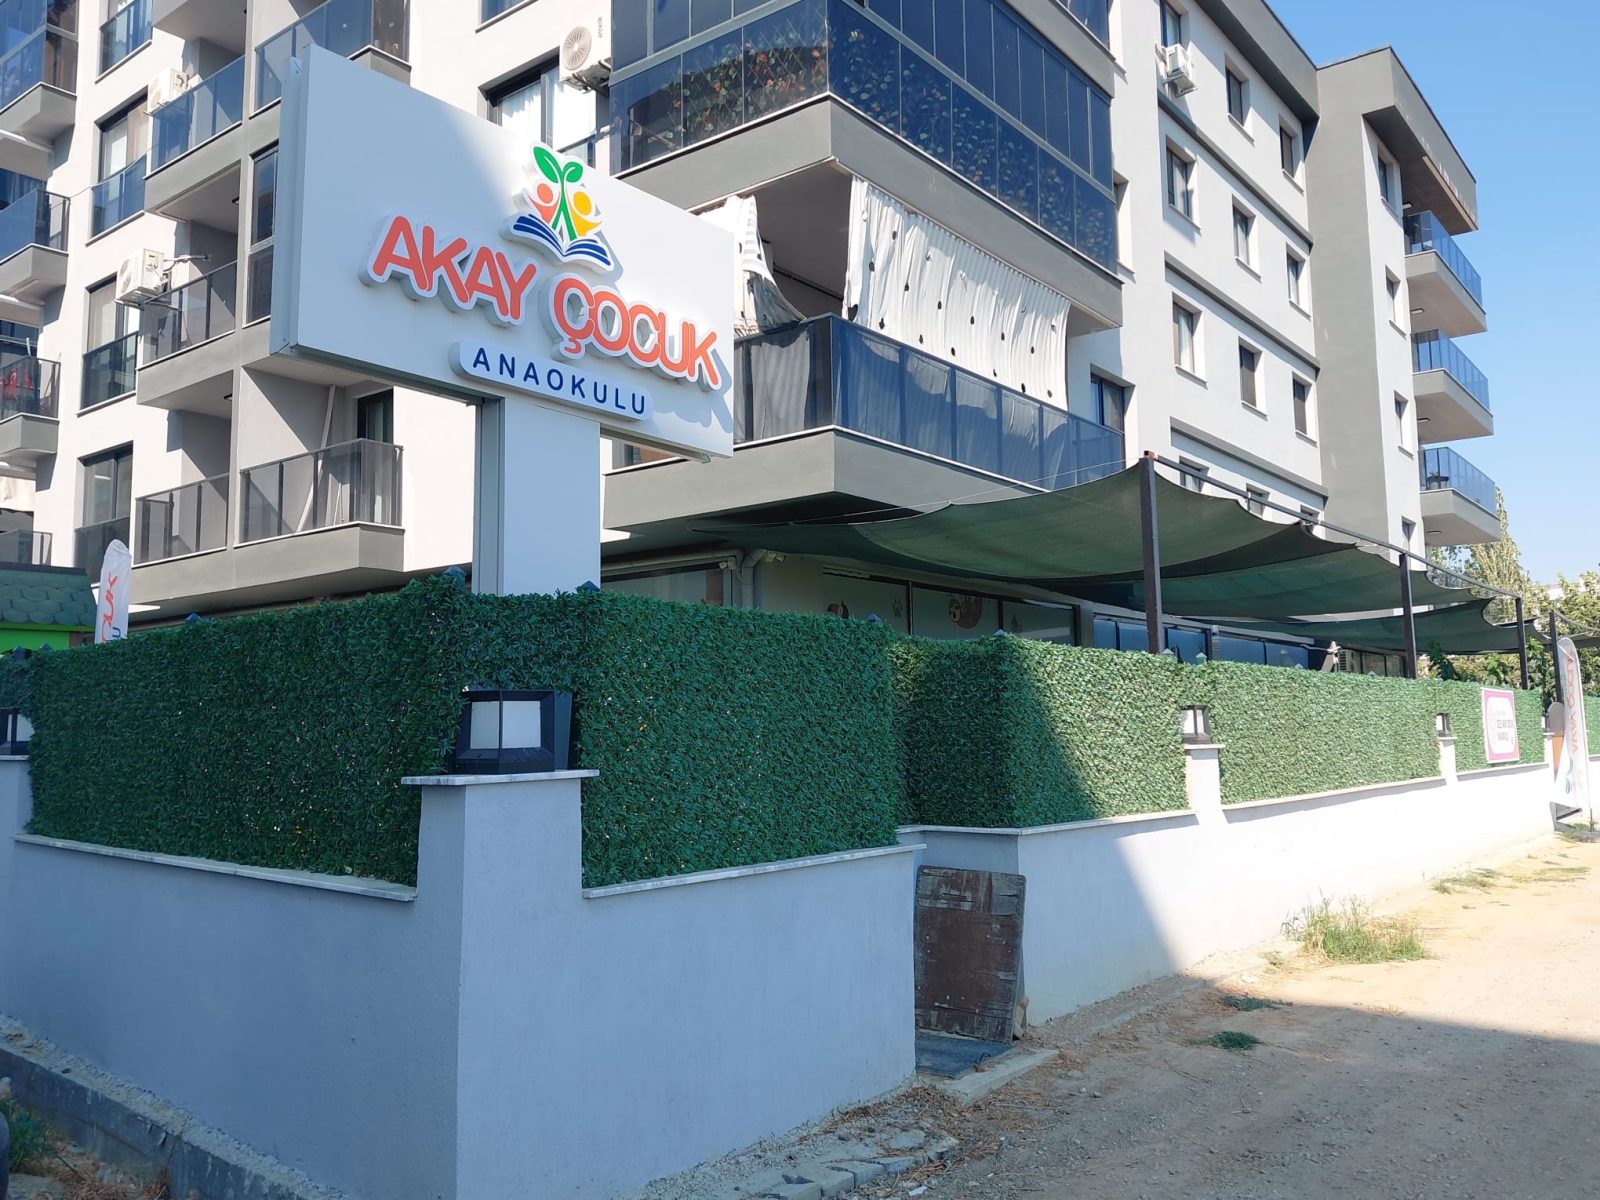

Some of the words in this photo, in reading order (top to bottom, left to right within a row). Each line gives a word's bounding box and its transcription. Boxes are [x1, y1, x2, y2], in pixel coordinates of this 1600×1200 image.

[372, 215, 537, 320] AKAY
[553, 277, 719, 386] ÇOCUK
[472, 348, 645, 415] ANAOKULU
